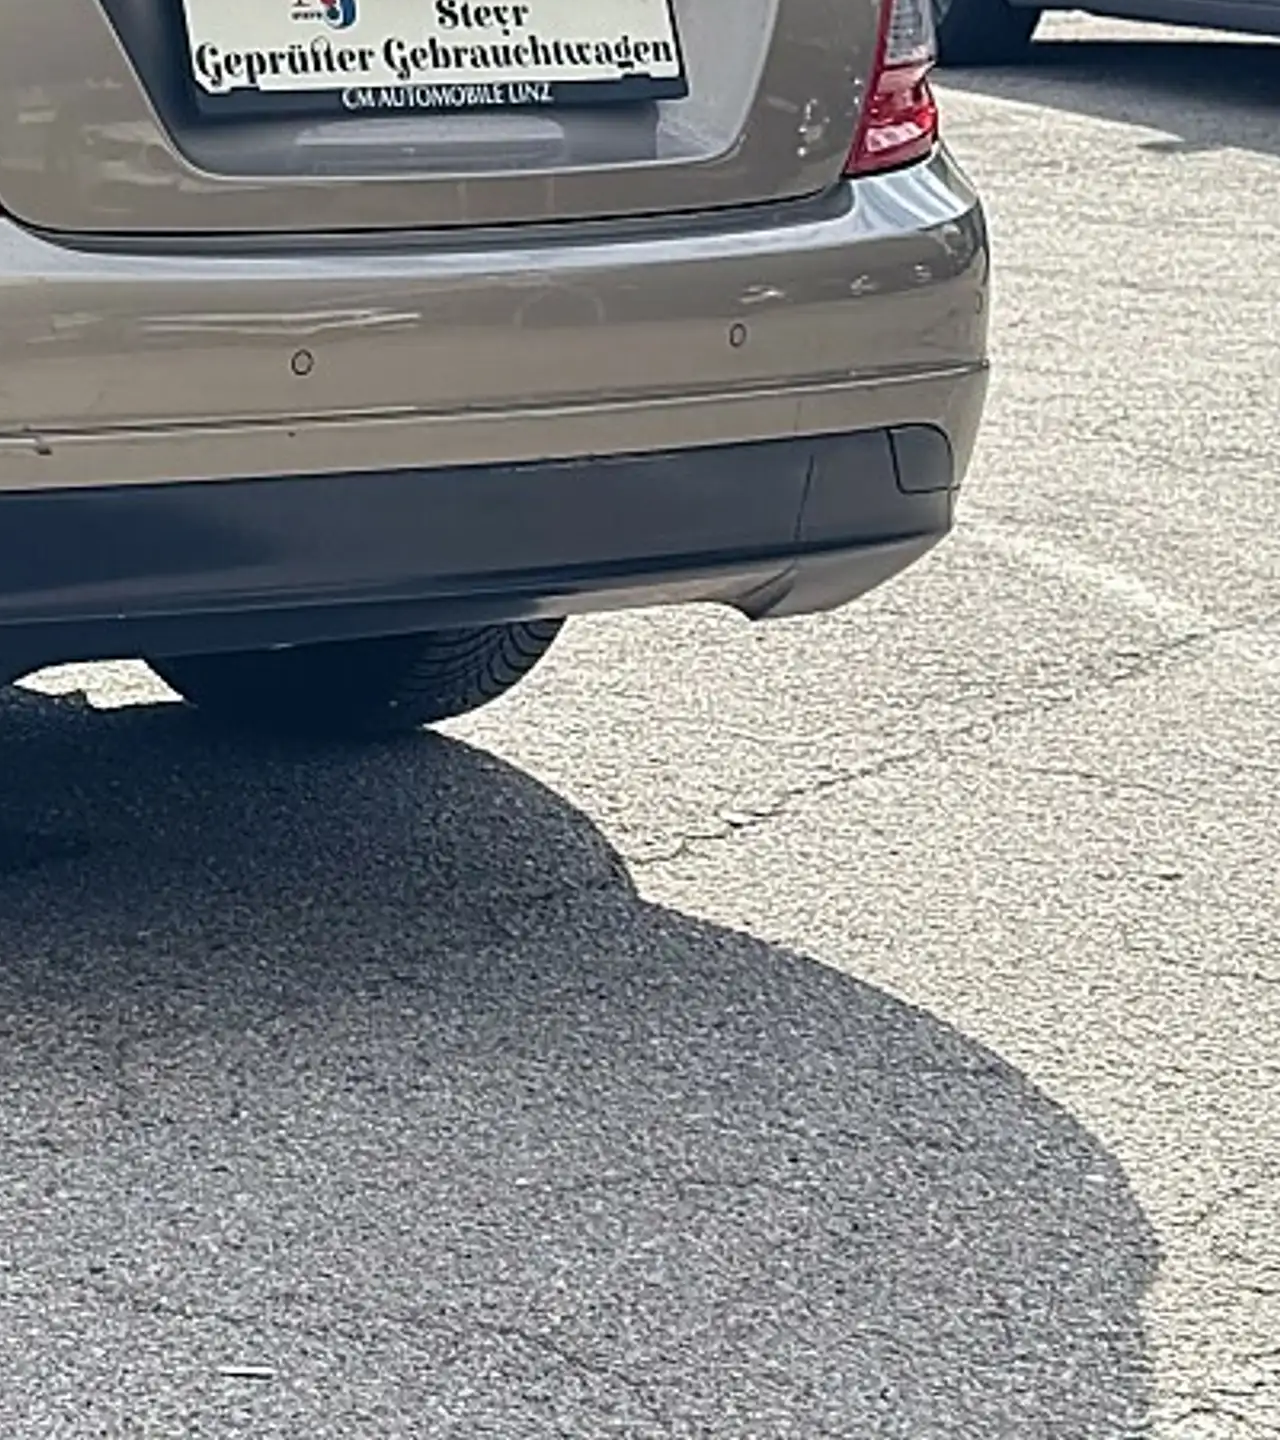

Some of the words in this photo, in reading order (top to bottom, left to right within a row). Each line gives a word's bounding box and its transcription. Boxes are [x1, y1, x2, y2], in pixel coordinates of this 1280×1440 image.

[195, 35, 375, 87] Geprüfter
[383, 34, 674, 81] Gebrauchtwagen
[377, 83, 504, 108] AUTOMOBILE
[508, 81, 555, 105] LINZ
